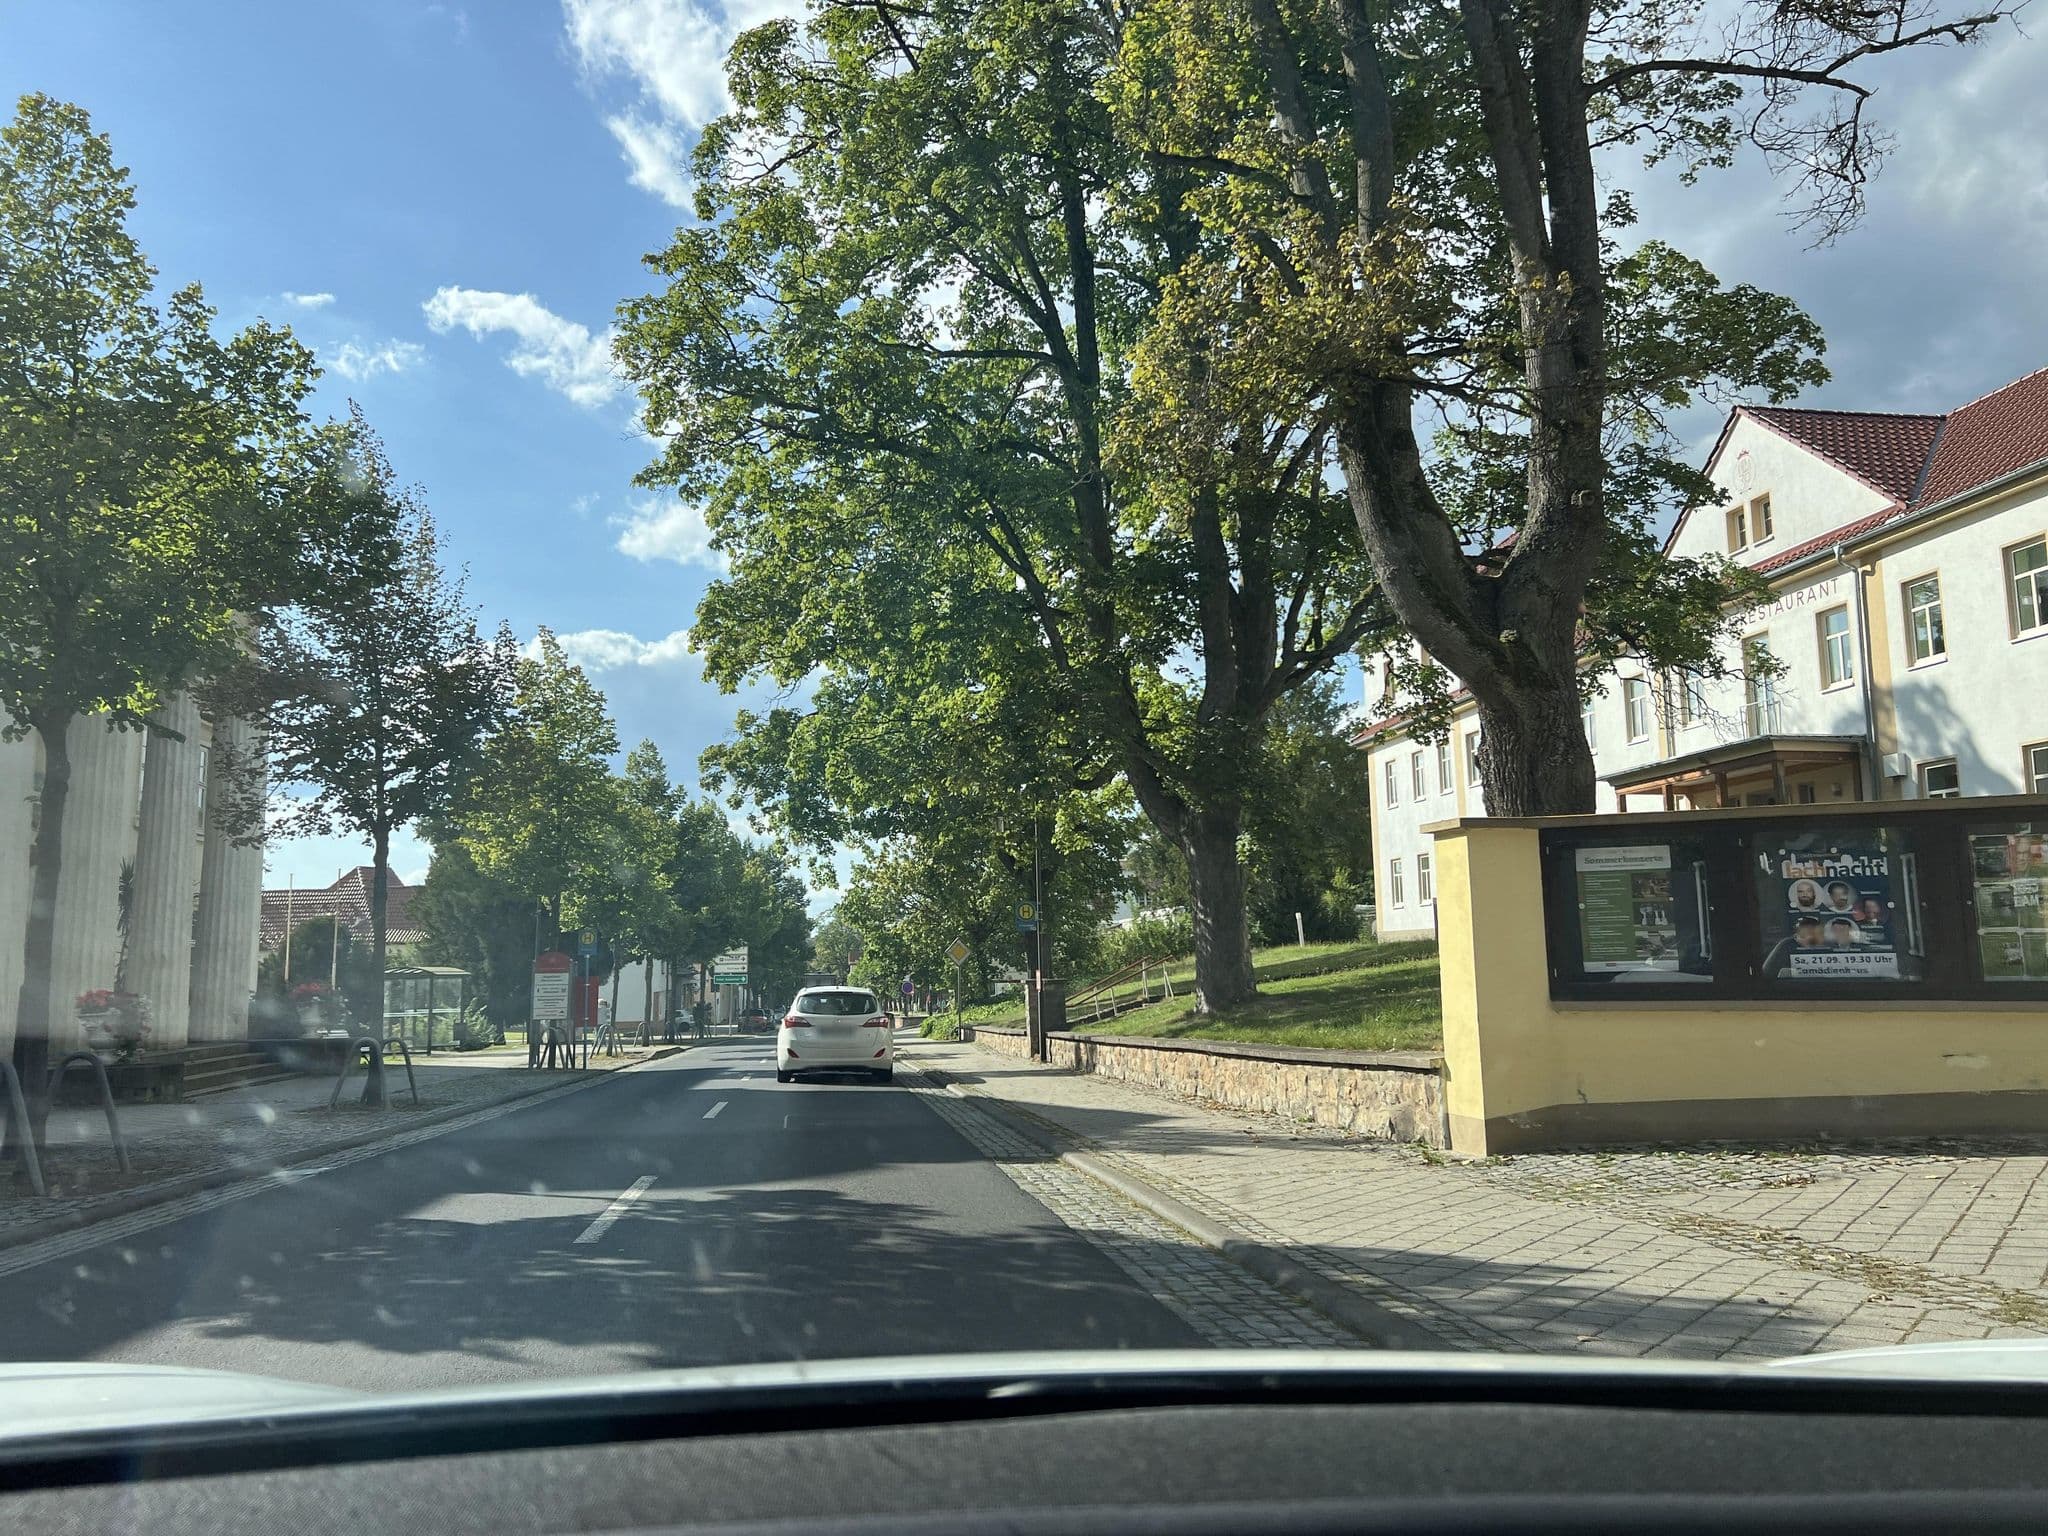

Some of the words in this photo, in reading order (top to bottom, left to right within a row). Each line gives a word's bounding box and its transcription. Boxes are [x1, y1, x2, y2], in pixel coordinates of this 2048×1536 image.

[1783, 855, 1887, 878] lachnacht
[1811, 956, 1840, 965] 21.09.
[1844, 955, 1872, 964] 19.30
[1875, 955, 1893, 964] Uhr
